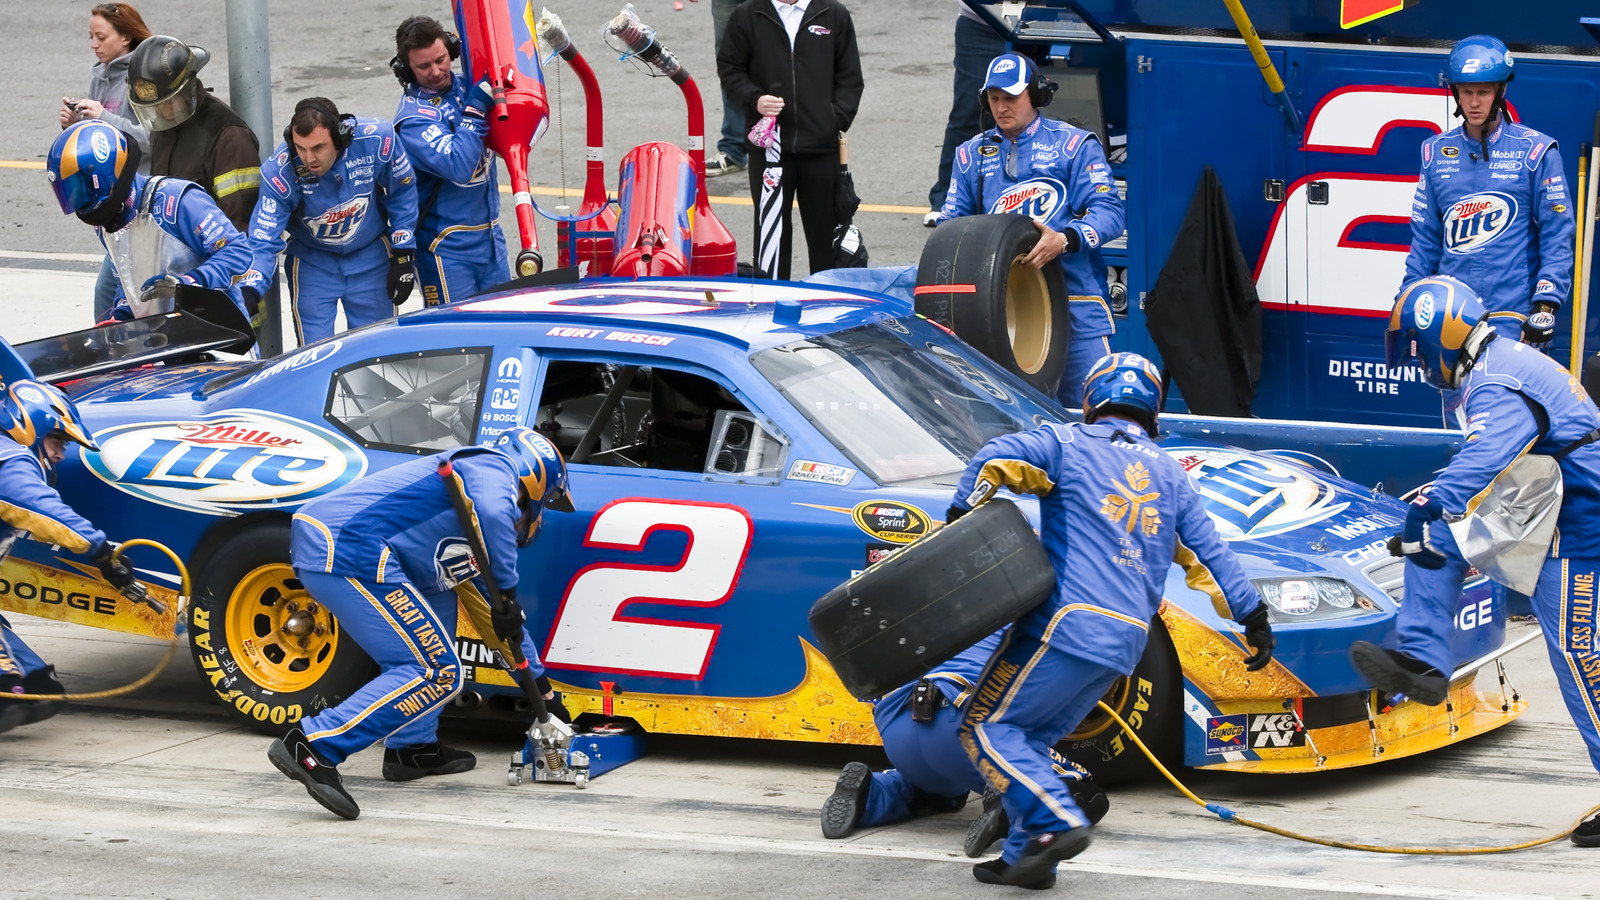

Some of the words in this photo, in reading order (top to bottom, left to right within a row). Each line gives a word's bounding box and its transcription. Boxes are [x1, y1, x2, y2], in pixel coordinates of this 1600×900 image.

[1461, 58, 1480, 74] 2
[346, 156, 366, 169] Mobil
[1489, 162, 1519, 170] LENNOX
[1491, 150, 1515, 159] Mobil
[349, 168, 374, 180] LENNOX
[1490, 172, 1519, 180] Snap-on
[999, 187, 1041, 212] Miller
[1003, 193, 1051, 219] ite
[1252, 84, 1522, 318] 2
[1455, 201, 1493, 218] Miller
[321, 202, 362, 225] Miller
[1447, 208, 1504, 250] Lite
[545, 327, 604, 339] KURT
[604, 331, 677, 347] BUSCH
[241, 345, 322, 389] LENNOX
[1329, 360, 1427, 384] DISCOUNT
[491, 388, 520, 409] PPG
[1356, 381, 1399, 395] TIRE
[493, 413, 522, 423] BOSCH
[176, 422, 303, 449] Miller
[481, 426, 505, 436] Maz
[483, 440, 496, 448] MAG
[1111, 440, 1160, 459] LITTAU
[115, 438, 329, 491] Lite
[876, 507, 907, 518] NASCAR
[878, 517, 905, 529] Sprint
[1324, 515, 1385, 541] Mobil
[1342, 536, 1393, 567] CHR
[543, 498, 754, 681] 2
[1280, 580, 1311, 610] 2
[1573, 571, 1595, 623] FILLING.
[384, 588, 425, 625] GREAT
[1453, 598, 1493, 631] GE
[1572, 625, 1592, 651] ESS
[977, 660, 1021, 708] FILLING.
[393, 683, 446, 717] FILLING.
[1210, 727, 1245, 738] SUNOCO
